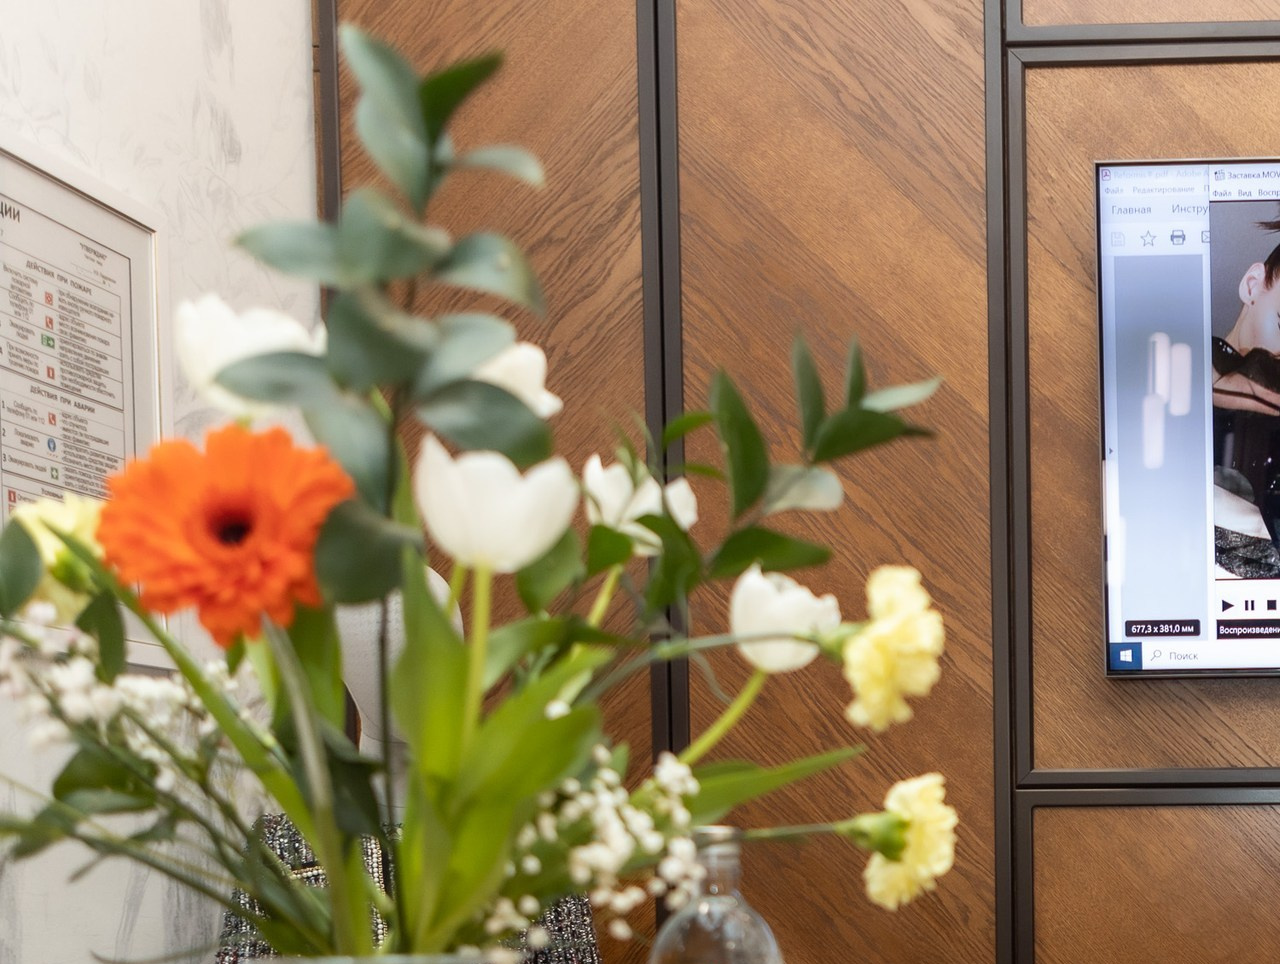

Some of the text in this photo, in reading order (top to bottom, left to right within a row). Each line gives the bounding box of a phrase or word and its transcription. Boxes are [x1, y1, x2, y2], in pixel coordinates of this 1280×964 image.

[1104, 187, 1124, 195] Файл
[1132, 186, 1195, 195] Редактирование
[1212, 190, 1232, 198] Файл
[1238, 189, 1252, 197] Вид
[1111, 205, 1152, 215] Главная
[26, 260, 55, 279] ДЕЙСТВИЯ
[56, 274, 68, 285] ПРИ
[70, 280, 92, 296] ПОЖАРЕ
[30, 385, 95, 414] ДЕЙСТВИЯ ПРИ АВАРИИ
[1131, 624, 1151, 634] 677,3
[1159, 624, 1180, 634] 381,0
[1169, 651, 1198, 661] Поиск
